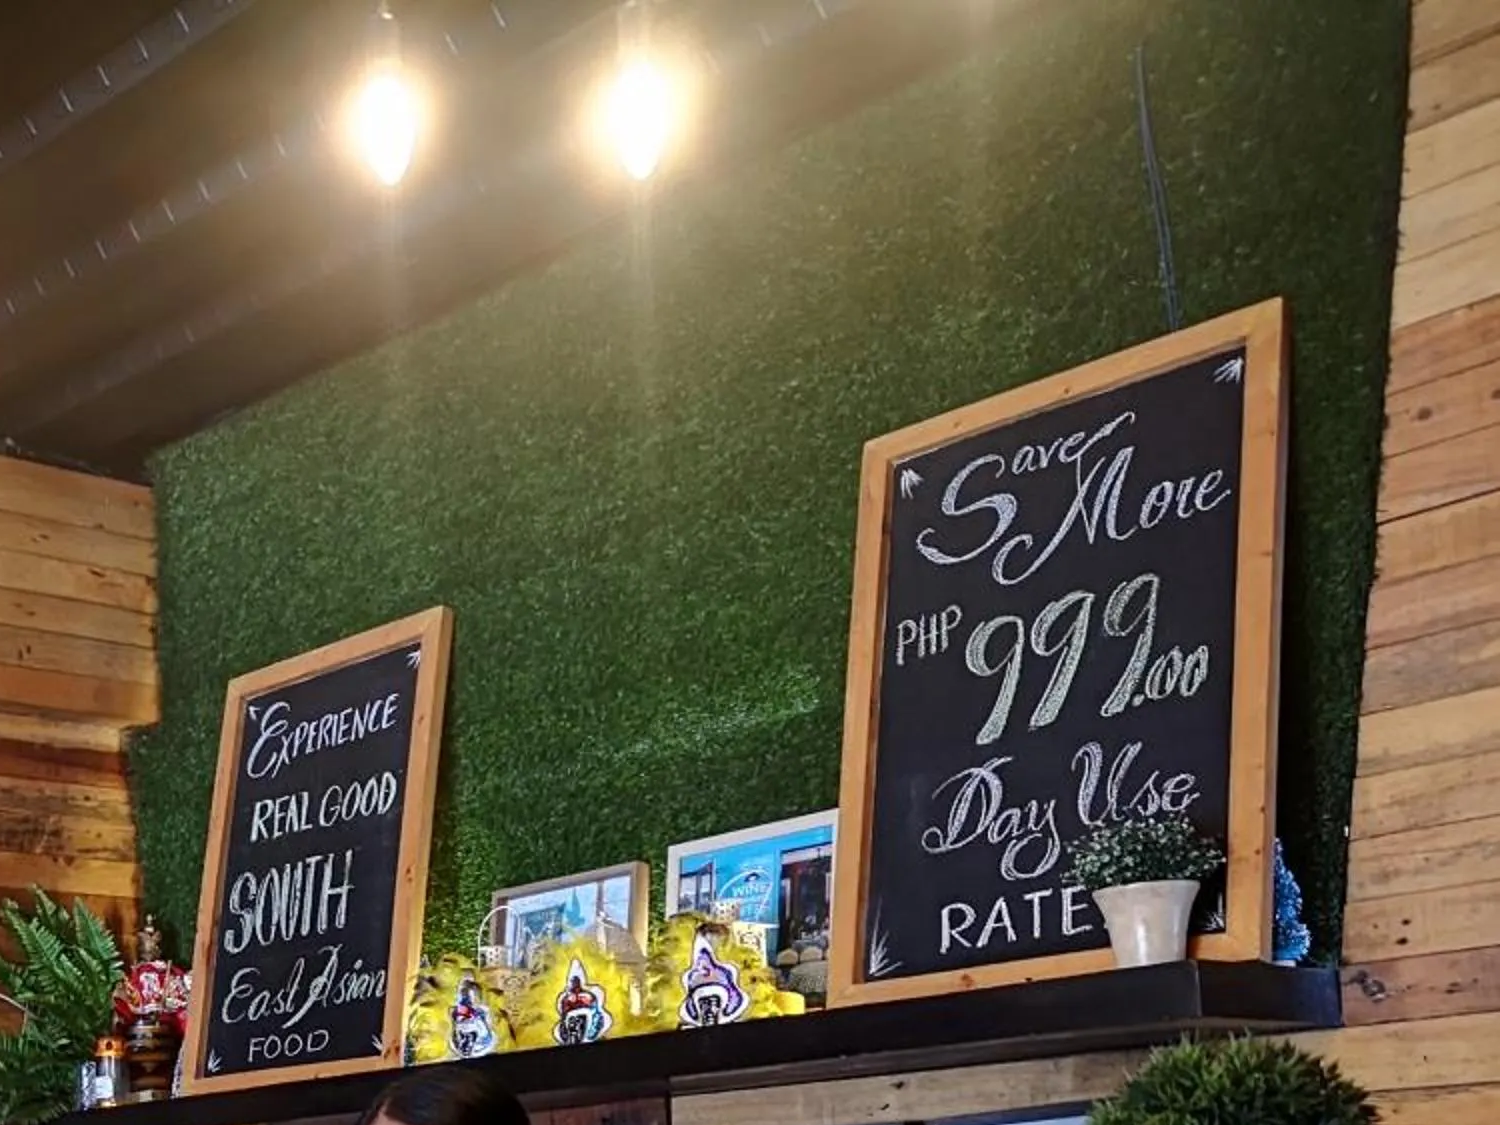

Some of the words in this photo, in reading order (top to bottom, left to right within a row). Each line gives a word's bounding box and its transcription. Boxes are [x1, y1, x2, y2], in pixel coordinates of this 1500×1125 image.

[916, 431, 1086, 564] Save
[992, 411, 1232, 585] More
[895, 604, 962, 665] PHP
[246, 693, 401, 780] EXPERIENCE
[250, 790, 314, 843] REAL
[319, 772, 397, 827] GOOD
[921, 755, 1061, 881] Day
[1071, 740, 1200, 827] Use
[224, 849, 355, 954] SOUTH
[222, 957, 305, 1024] East
[282, 944, 386, 1029] Asian
[247, 1029, 330, 1063] FOOD
